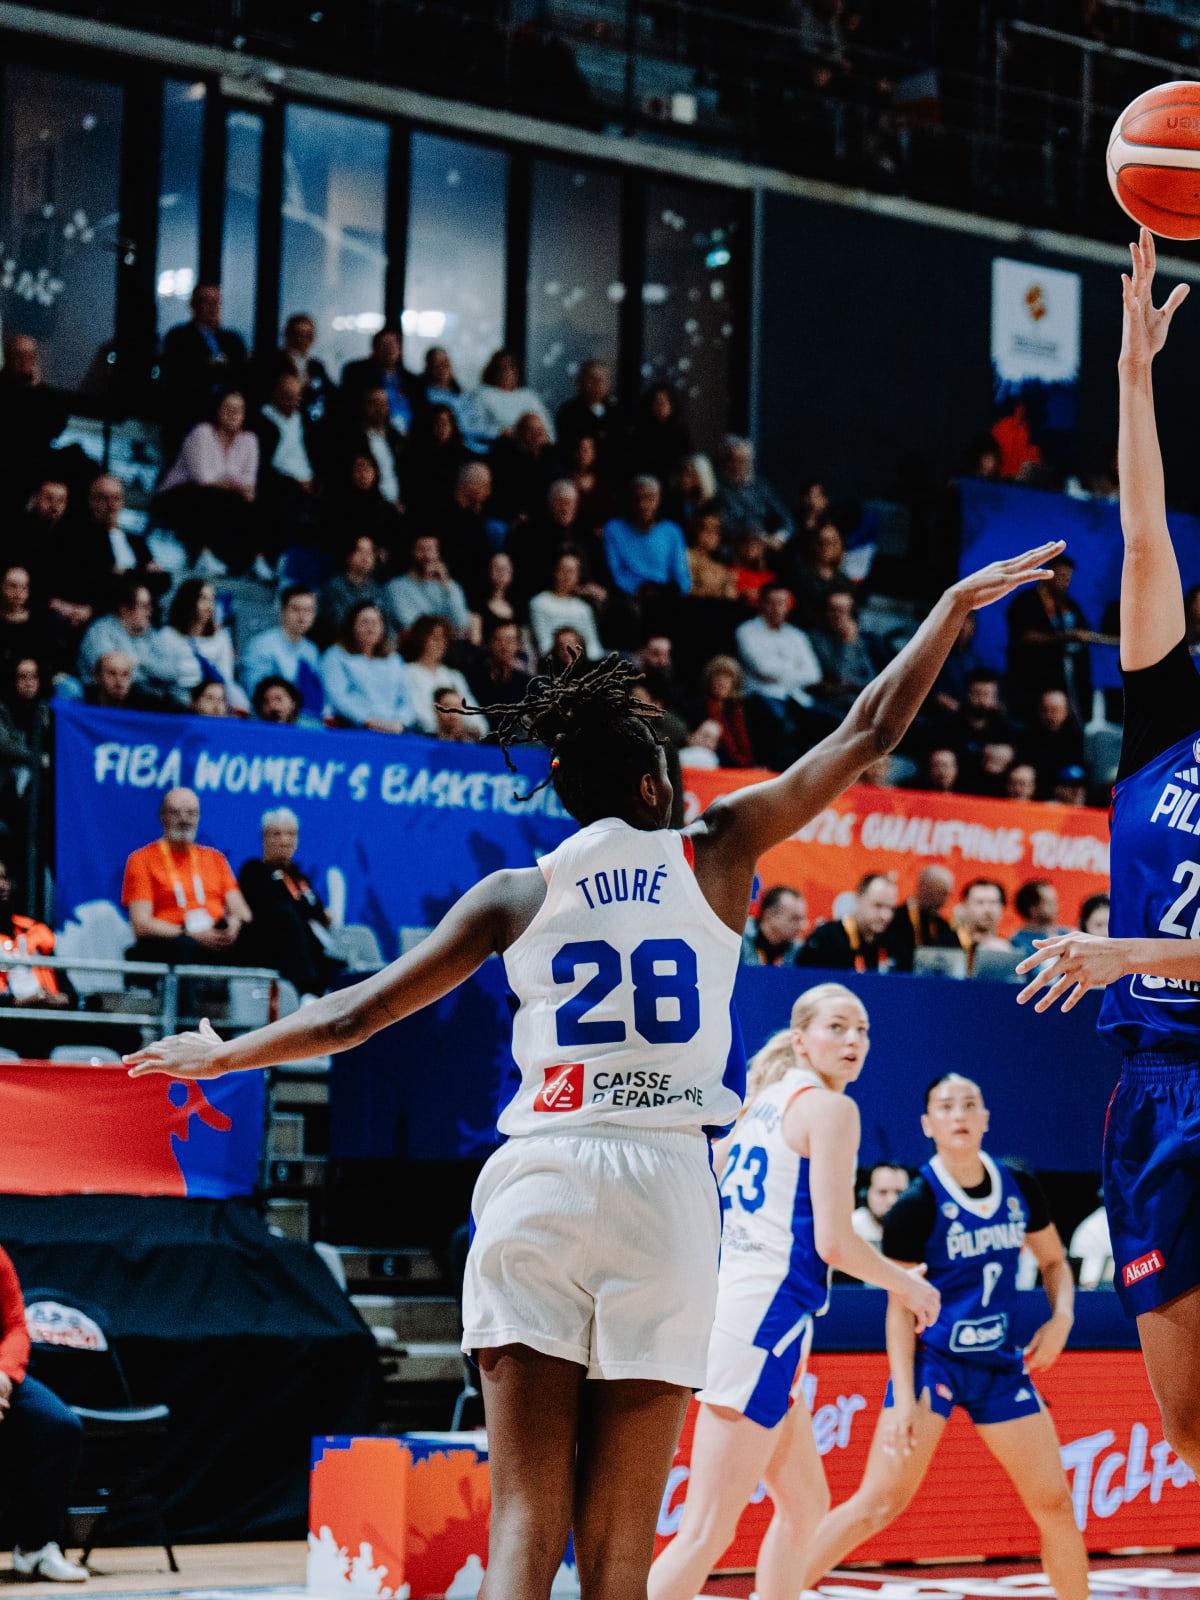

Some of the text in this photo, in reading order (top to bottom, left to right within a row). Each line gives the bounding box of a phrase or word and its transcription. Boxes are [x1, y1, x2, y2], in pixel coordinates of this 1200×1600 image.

[94, 742, 181, 789] FIBA
[194, 750, 370, 802] WOMEN'S
[861, 811, 1024, 865] QUALIFYING
[575, 863, 668, 910] TOURÉ
[551, 938, 701, 1047] 28
[592, 1070, 673, 1092] CAISSE
[719, 1143, 769, 1215] 23
[1125, 1252, 1162, 1284] Akari
